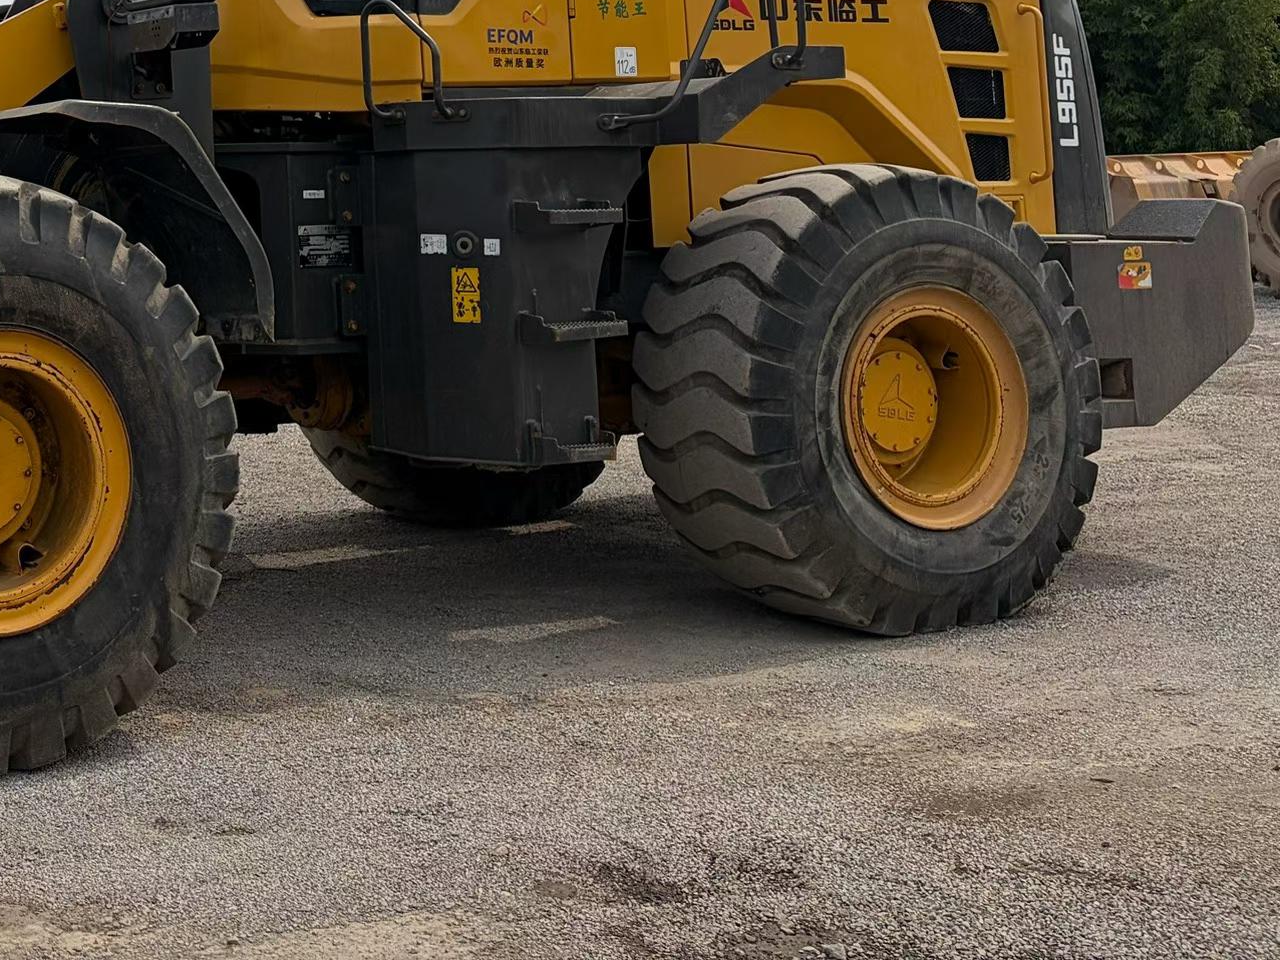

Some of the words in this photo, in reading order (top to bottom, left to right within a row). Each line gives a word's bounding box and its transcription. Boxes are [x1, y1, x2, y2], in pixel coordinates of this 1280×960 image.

[487, 28, 534, 45] EFQM
[493, 57, 545, 69] 欧洲质量奖
[1052, 33, 1080, 147] L955F
